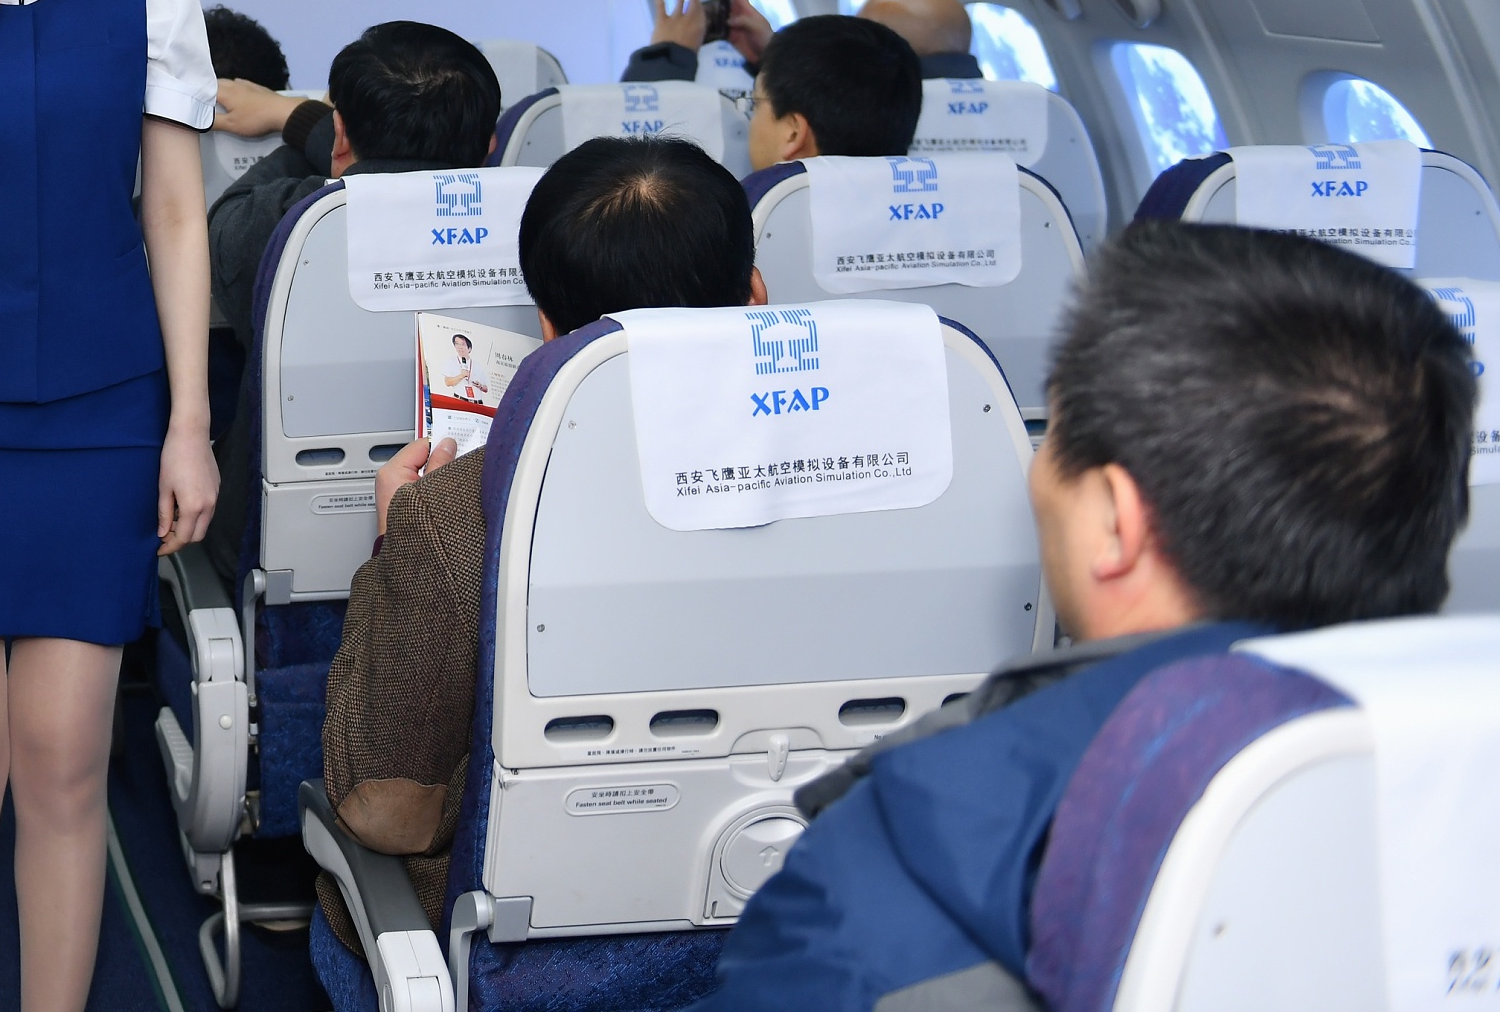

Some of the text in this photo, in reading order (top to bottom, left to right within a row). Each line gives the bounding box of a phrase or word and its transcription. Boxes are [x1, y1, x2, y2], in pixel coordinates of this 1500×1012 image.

[948, 101, 989, 114] XFAP
[622, 120, 664, 133] XFAP
[1311, 180, 1369, 197] XFAP
[888, 202, 944, 221] XFAP
[431, 227, 489, 246] XFAP
[472, 278, 512, 286] Simulation
[750, 386, 830, 417] XFAP
[675, 451, 911, 486] 西安飞鹰亚太航空模拟设备有限公司
[676, 467, 913, 497] Xifei Asia-pacific Aviation Simulation Co.,Ltd
